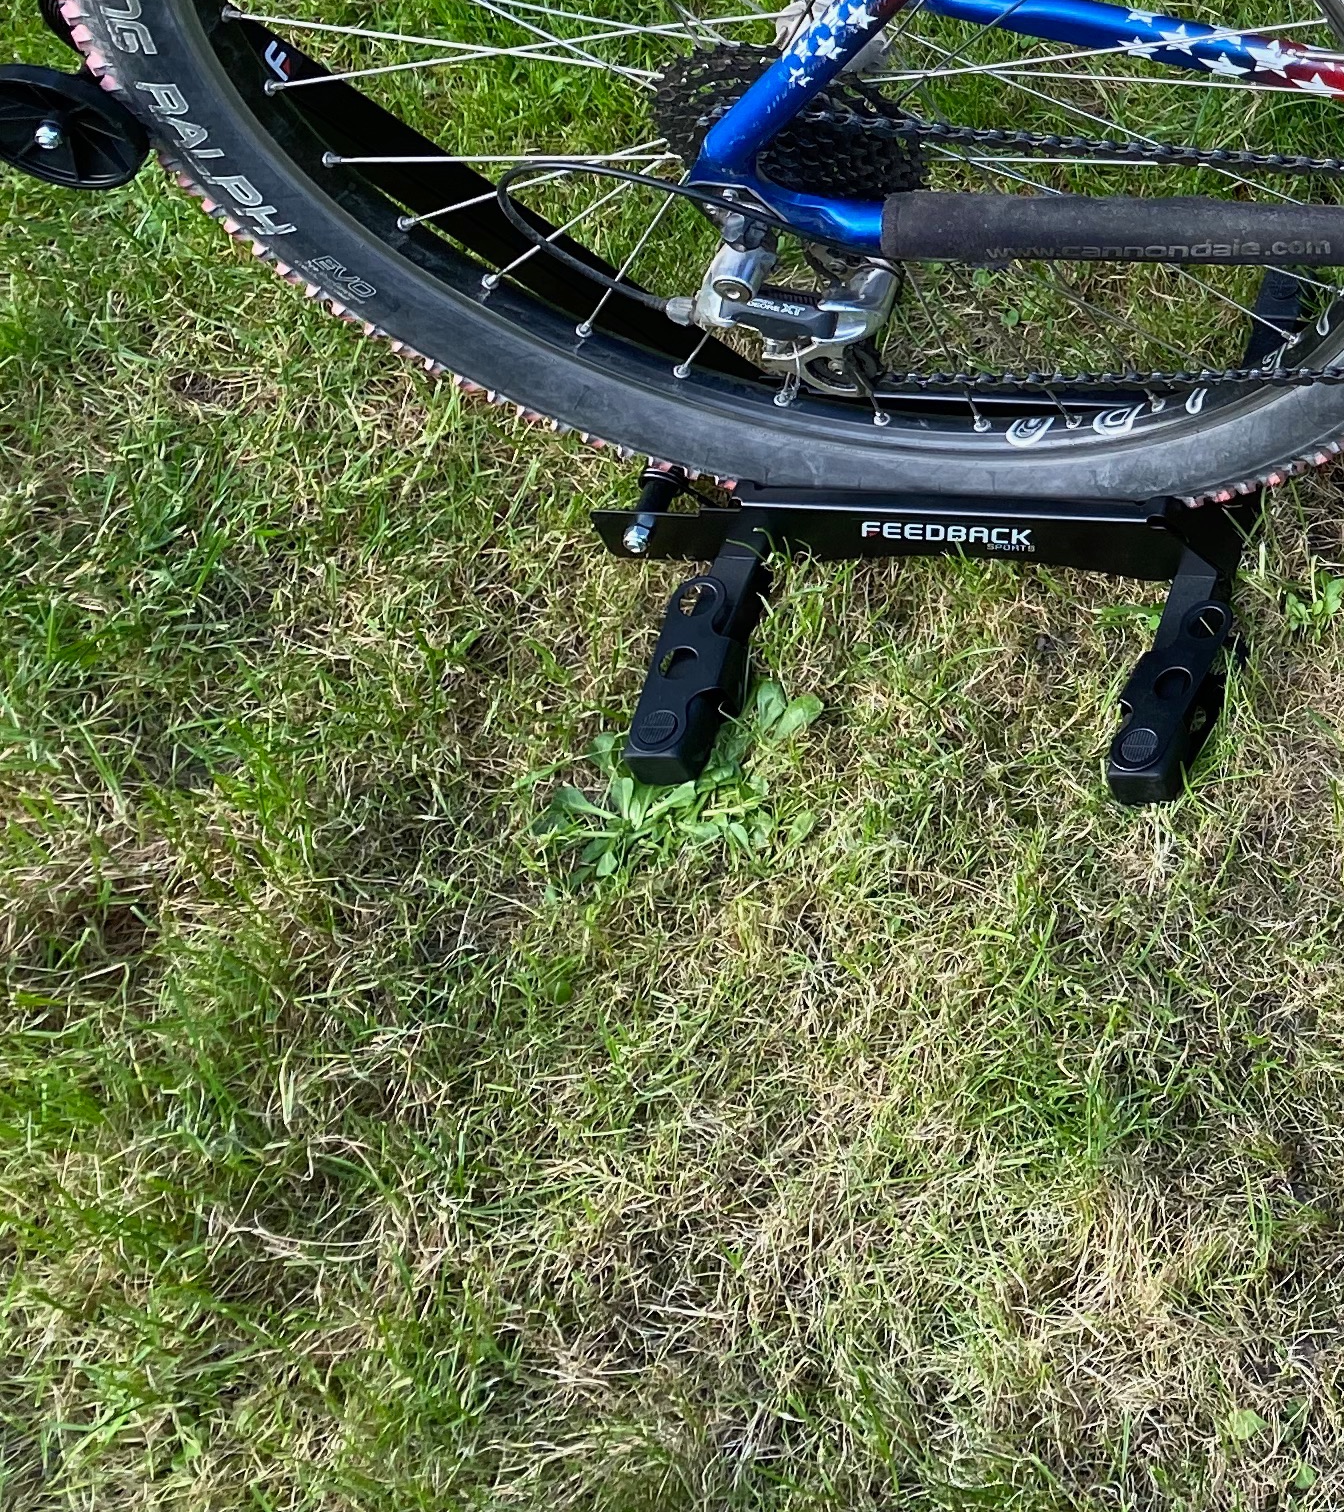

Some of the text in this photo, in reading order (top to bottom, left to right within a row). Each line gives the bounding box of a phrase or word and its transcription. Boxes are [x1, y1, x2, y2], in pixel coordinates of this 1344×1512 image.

[135, 80, 298, 237] RALPH
[311, 254, 378, 298] EVO
[780, 302, 806, 316] XT
[861, 521, 1033, 546] FEEDBACK
[986, 543, 1036, 553] SPORTS
